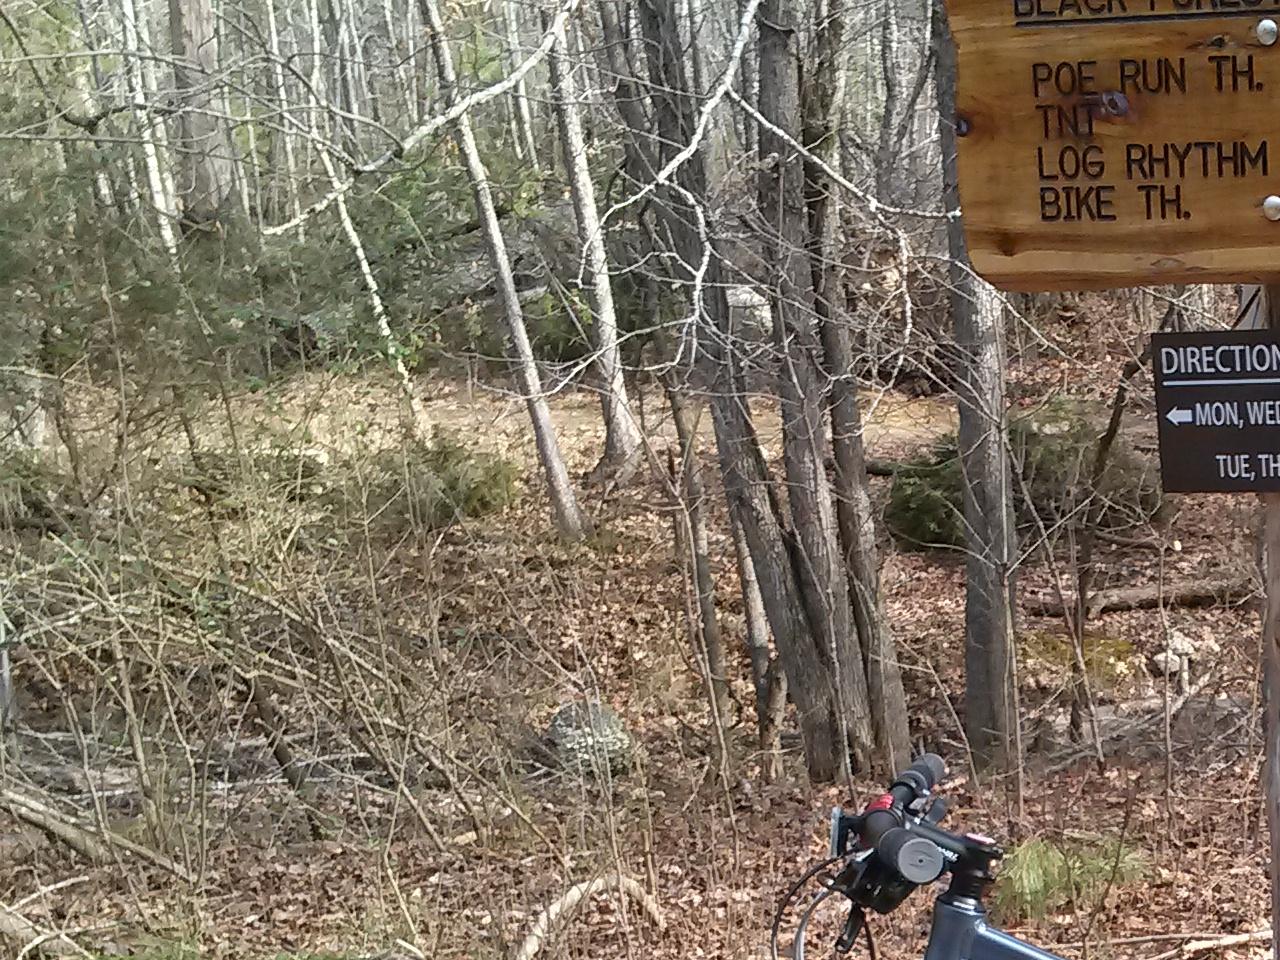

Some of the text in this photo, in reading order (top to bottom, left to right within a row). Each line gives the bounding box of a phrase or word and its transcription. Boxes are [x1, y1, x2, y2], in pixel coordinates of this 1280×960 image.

[1032, 60, 1099, 98] POE
[1119, 57, 1187, 95] RUN
[1208, 55, 1264, 93] TH.
[1035, 102, 1100, 139] TNT
[1037, 145, 1105, 180] LOG
[1125, 140, 1269, 180] RHYTHM
[1039, 185, 1117, 222] BIKE
[1137, 184, 1192, 220] TH.
[1195, 401, 1244, 429] MON,
[1215, 454, 1255, 481] TUE,
